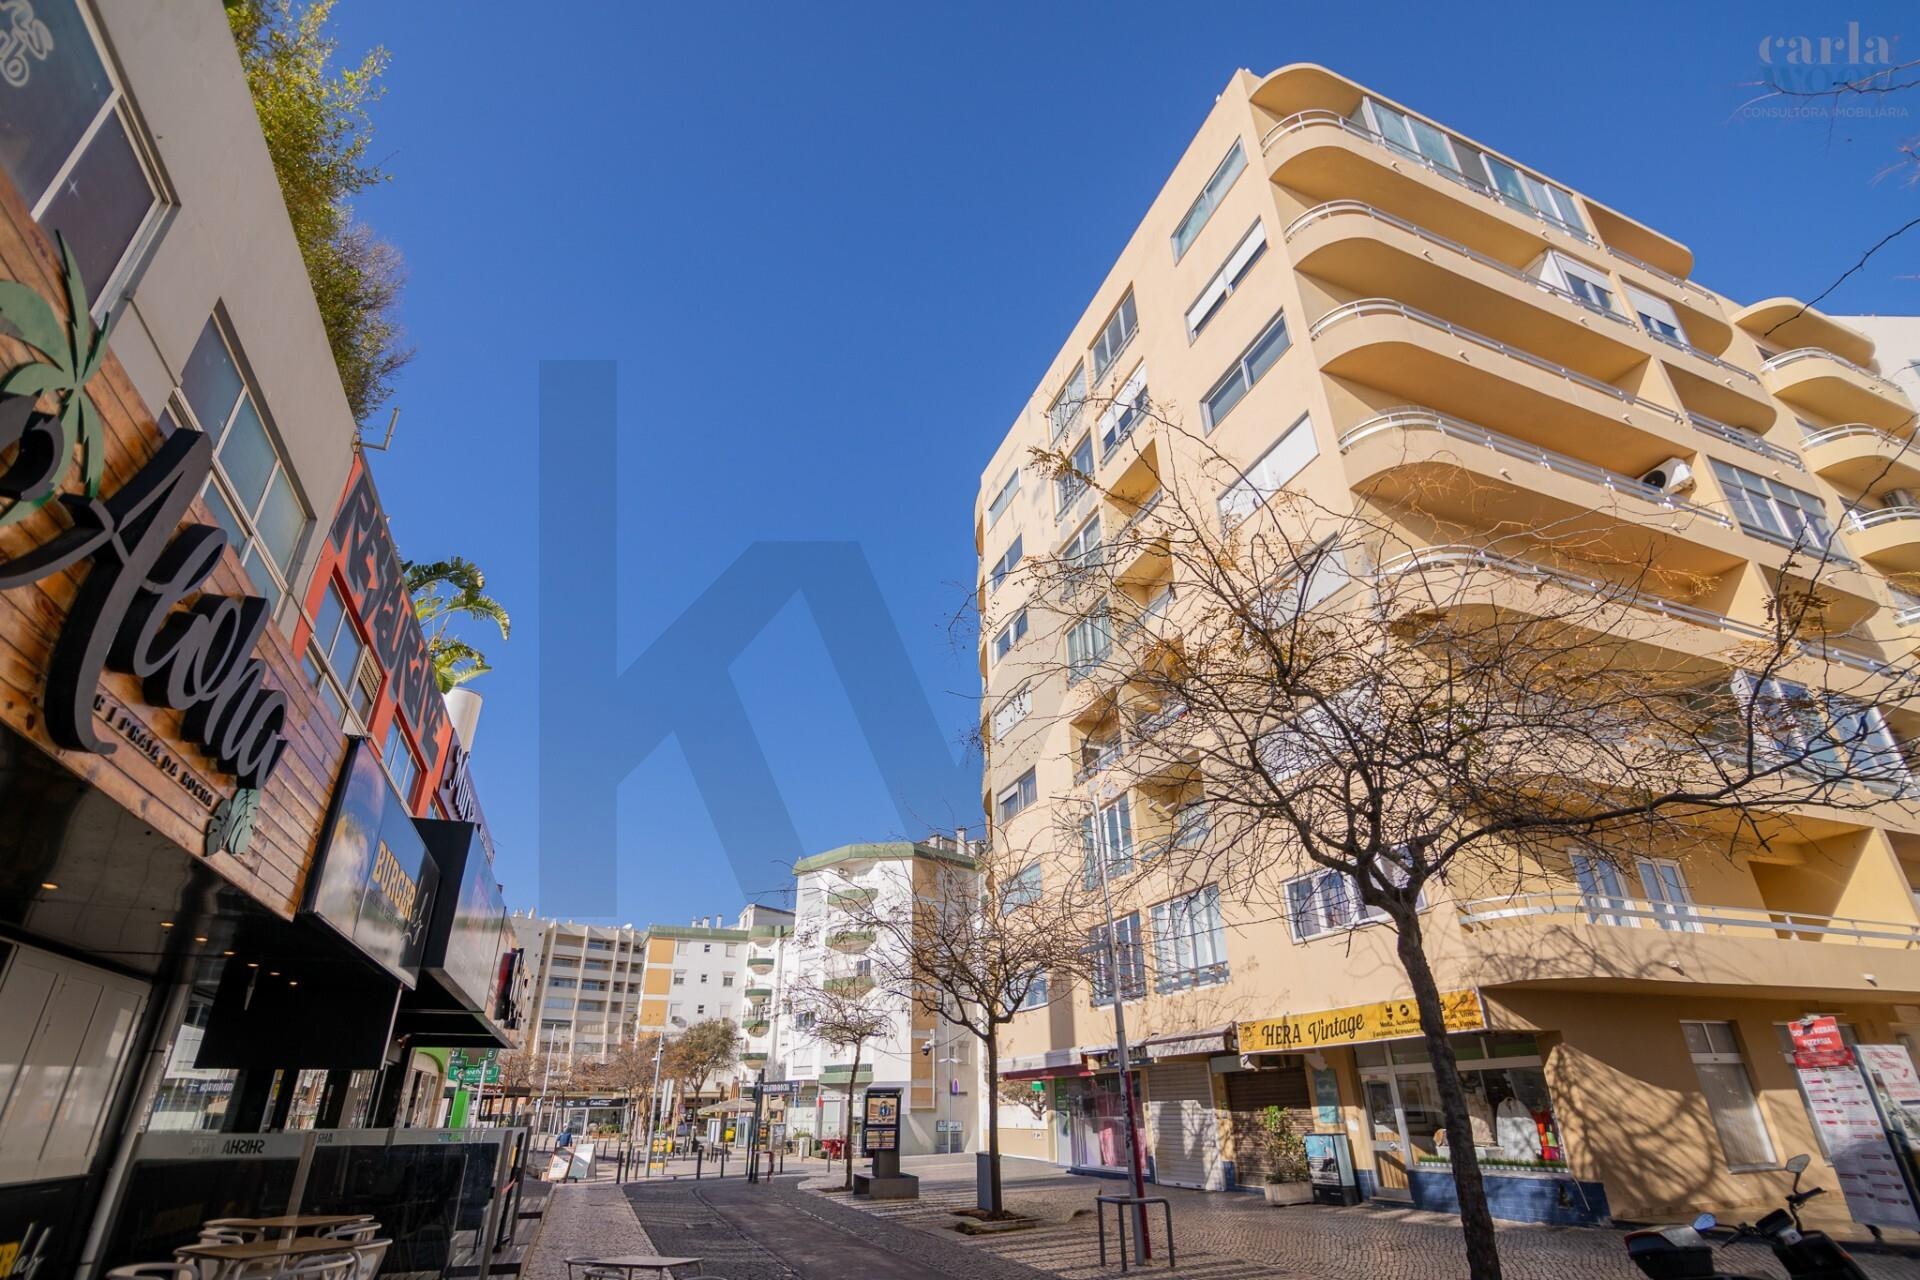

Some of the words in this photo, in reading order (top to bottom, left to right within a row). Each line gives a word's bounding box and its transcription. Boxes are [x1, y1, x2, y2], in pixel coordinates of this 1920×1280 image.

[372, 840, 417, 921] BURGER
[1261, 1023, 1302, 1046] HERA
[1308, 1013, 1365, 1045] Vintage
